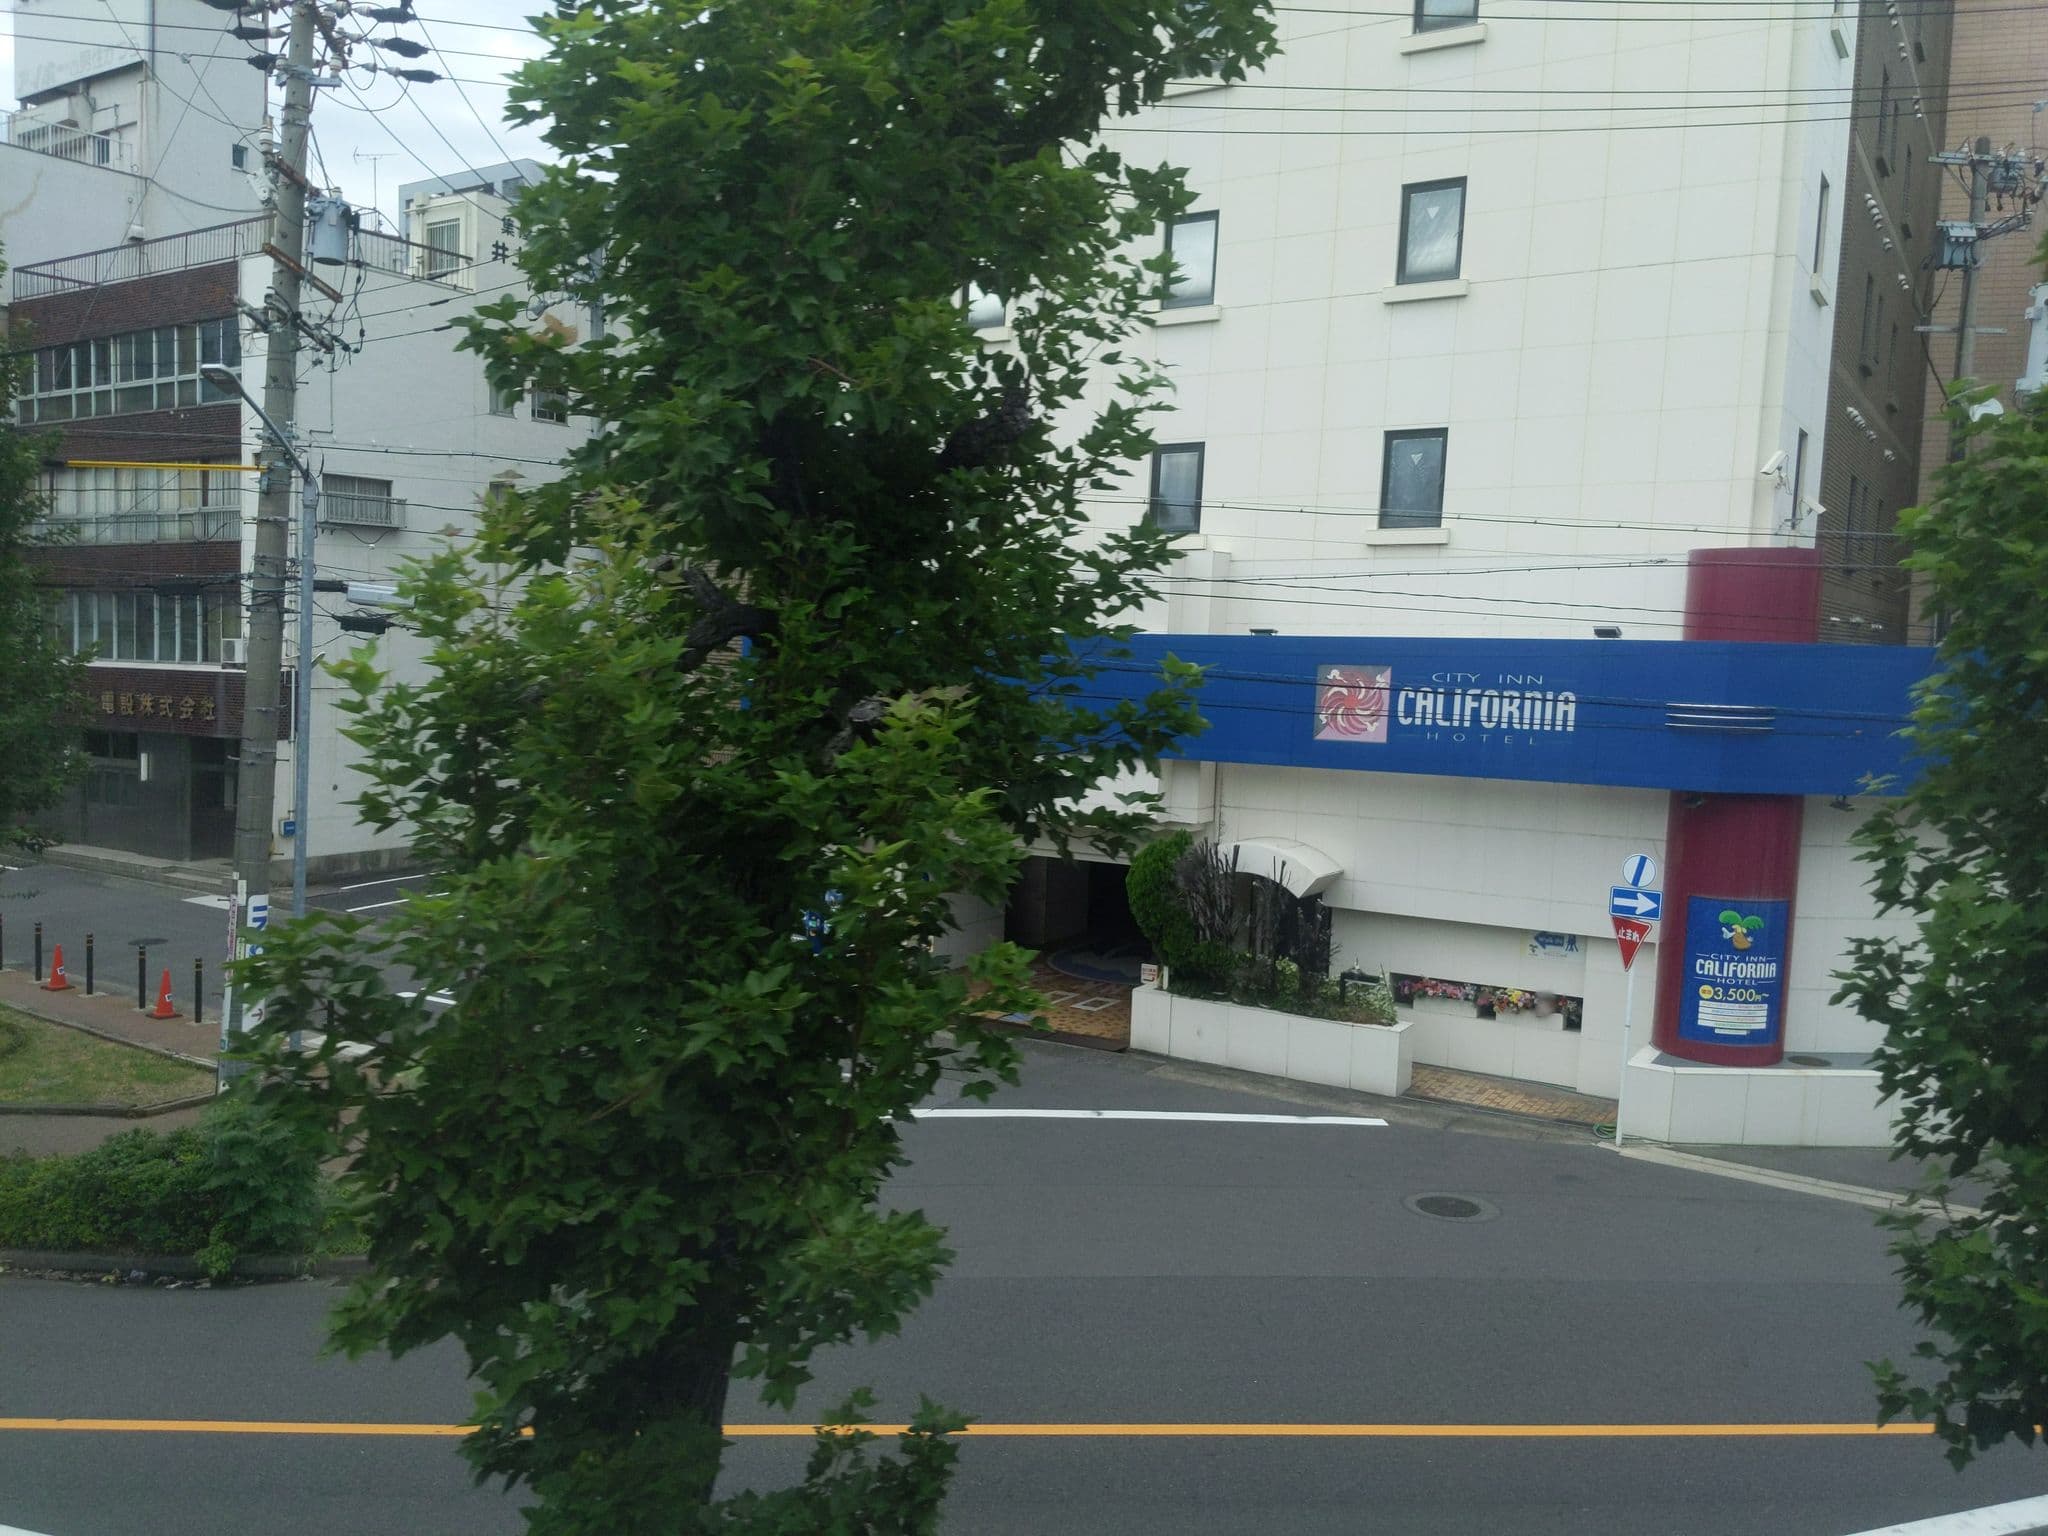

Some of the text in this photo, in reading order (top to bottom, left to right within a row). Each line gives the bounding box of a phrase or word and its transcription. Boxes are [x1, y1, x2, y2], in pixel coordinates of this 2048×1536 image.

[1432, 672, 1543, 685] CITY INN
[84, 690, 215, 720] 電設株式会社
[1397, 687, 1576, 731] CALIFORNIA
[1426, 732, 1536, 745] HOTEL
[1618, 927, 1640, 943] 止まれ
[1710, 953, 1740, 961] CITY
[1696, 959, 1776, 978] CALIFORNIA
[1717, 978, 1757, 986] HOTEL
